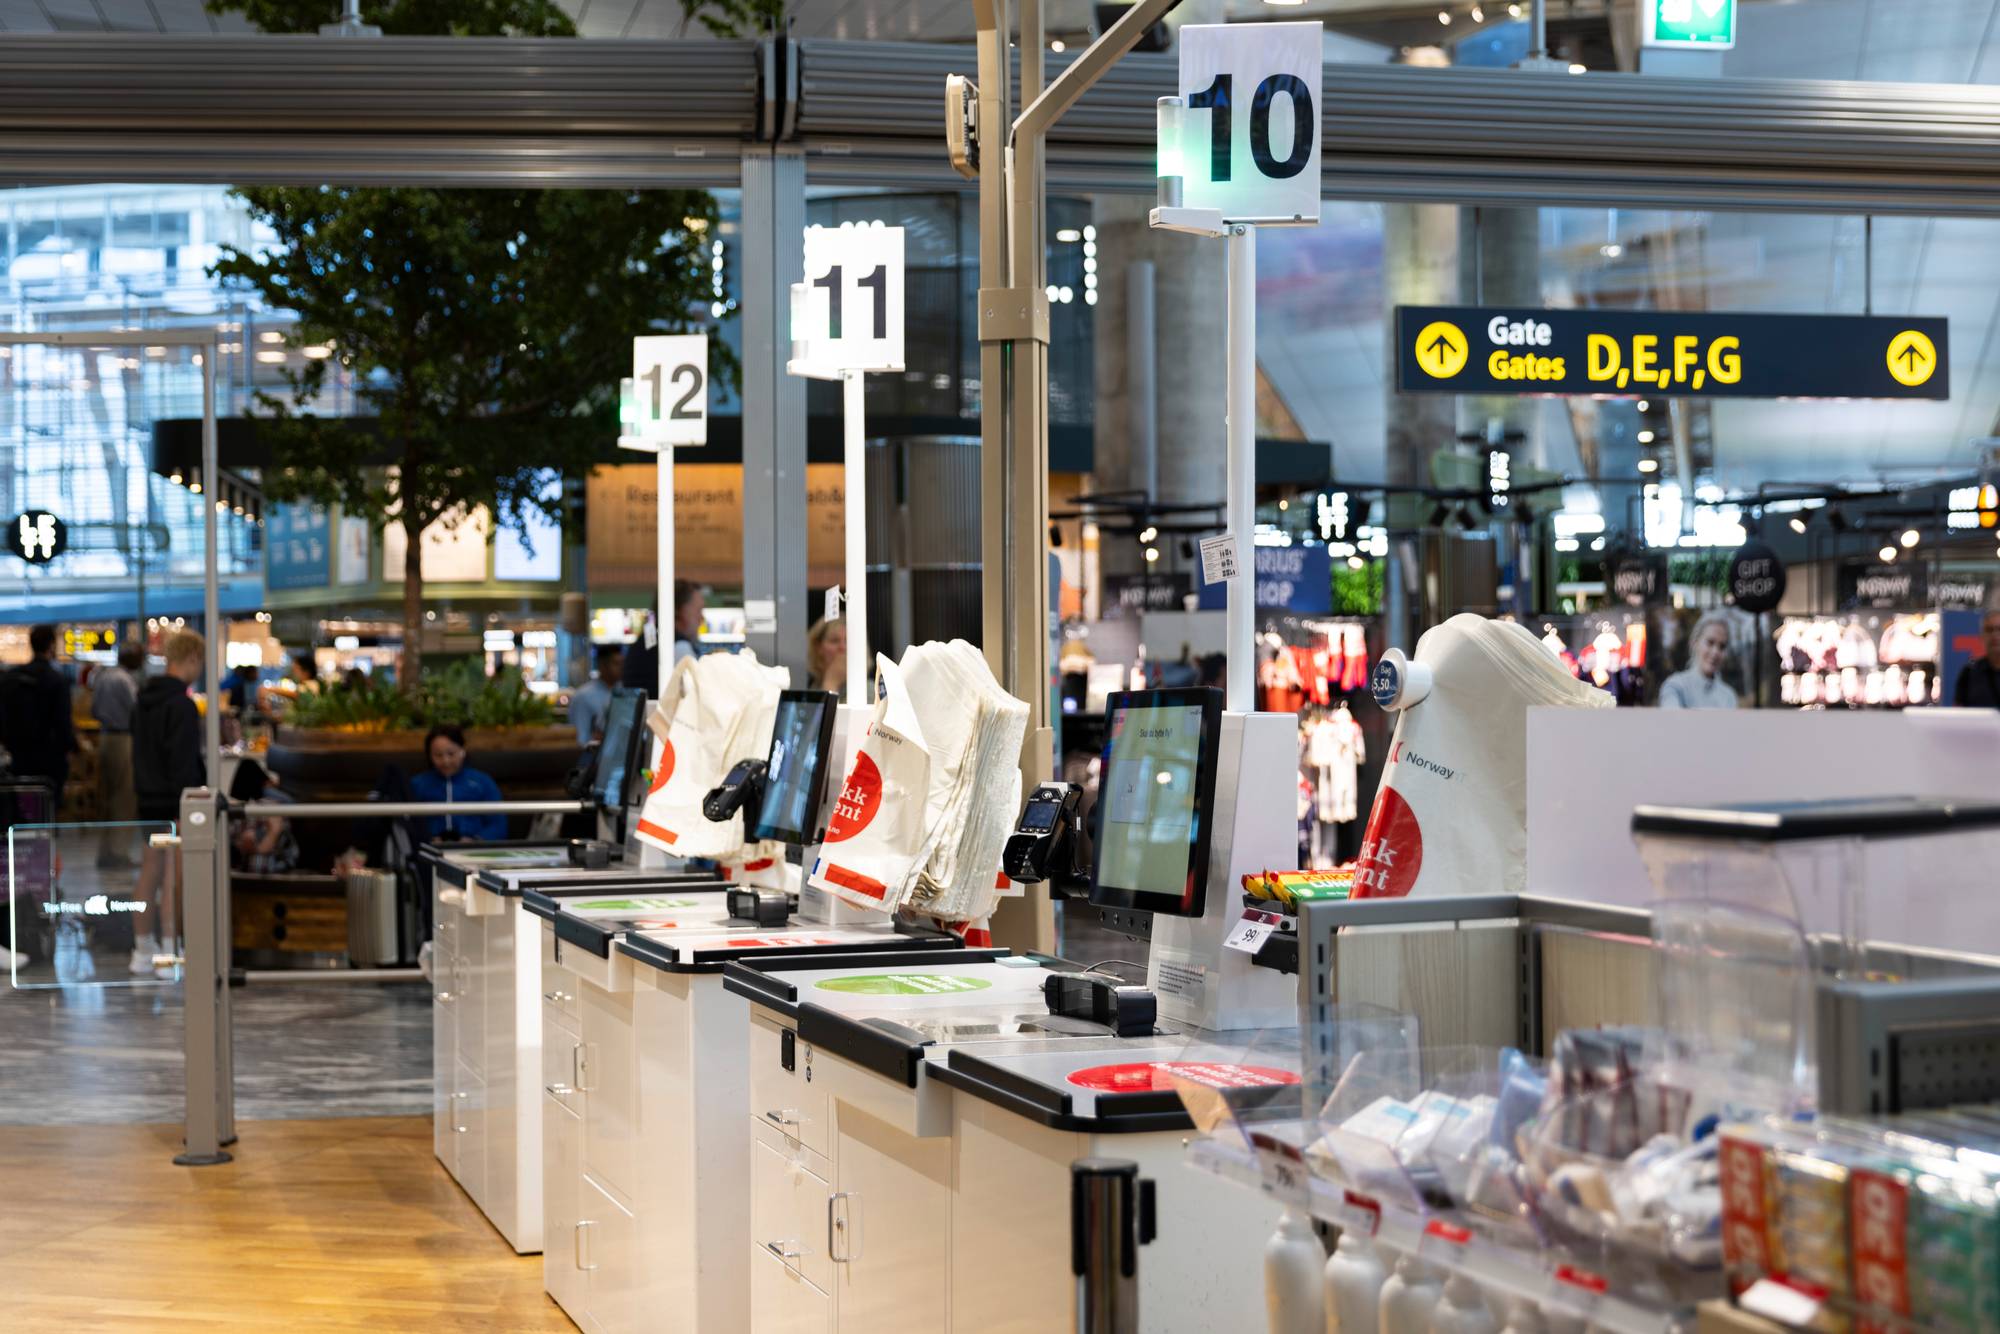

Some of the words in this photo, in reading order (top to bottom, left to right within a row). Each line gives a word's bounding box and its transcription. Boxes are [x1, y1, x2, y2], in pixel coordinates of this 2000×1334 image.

[1189, 73, 1315, 182] 10
[813, 264, 887, 339] 11
[1487, 316, 1552, 346] Gate
[1487, 349, 1566, 381] Gates
[1586, 333, 1742, 390] D,E,F,G
[640, 363, 703, 420] 12
[626, 485, 736, 505] Resaurant
[1737, 557, 1771, 578] GIFT
[1733, 578, 1777, 597] SHOP
[1380, 665, 1392, 676] Bag
[1373, 678, 1390, 692] 5,50
[874, 728, 903, 746] Norway
[1405, 751, 1455, 780] Norway
